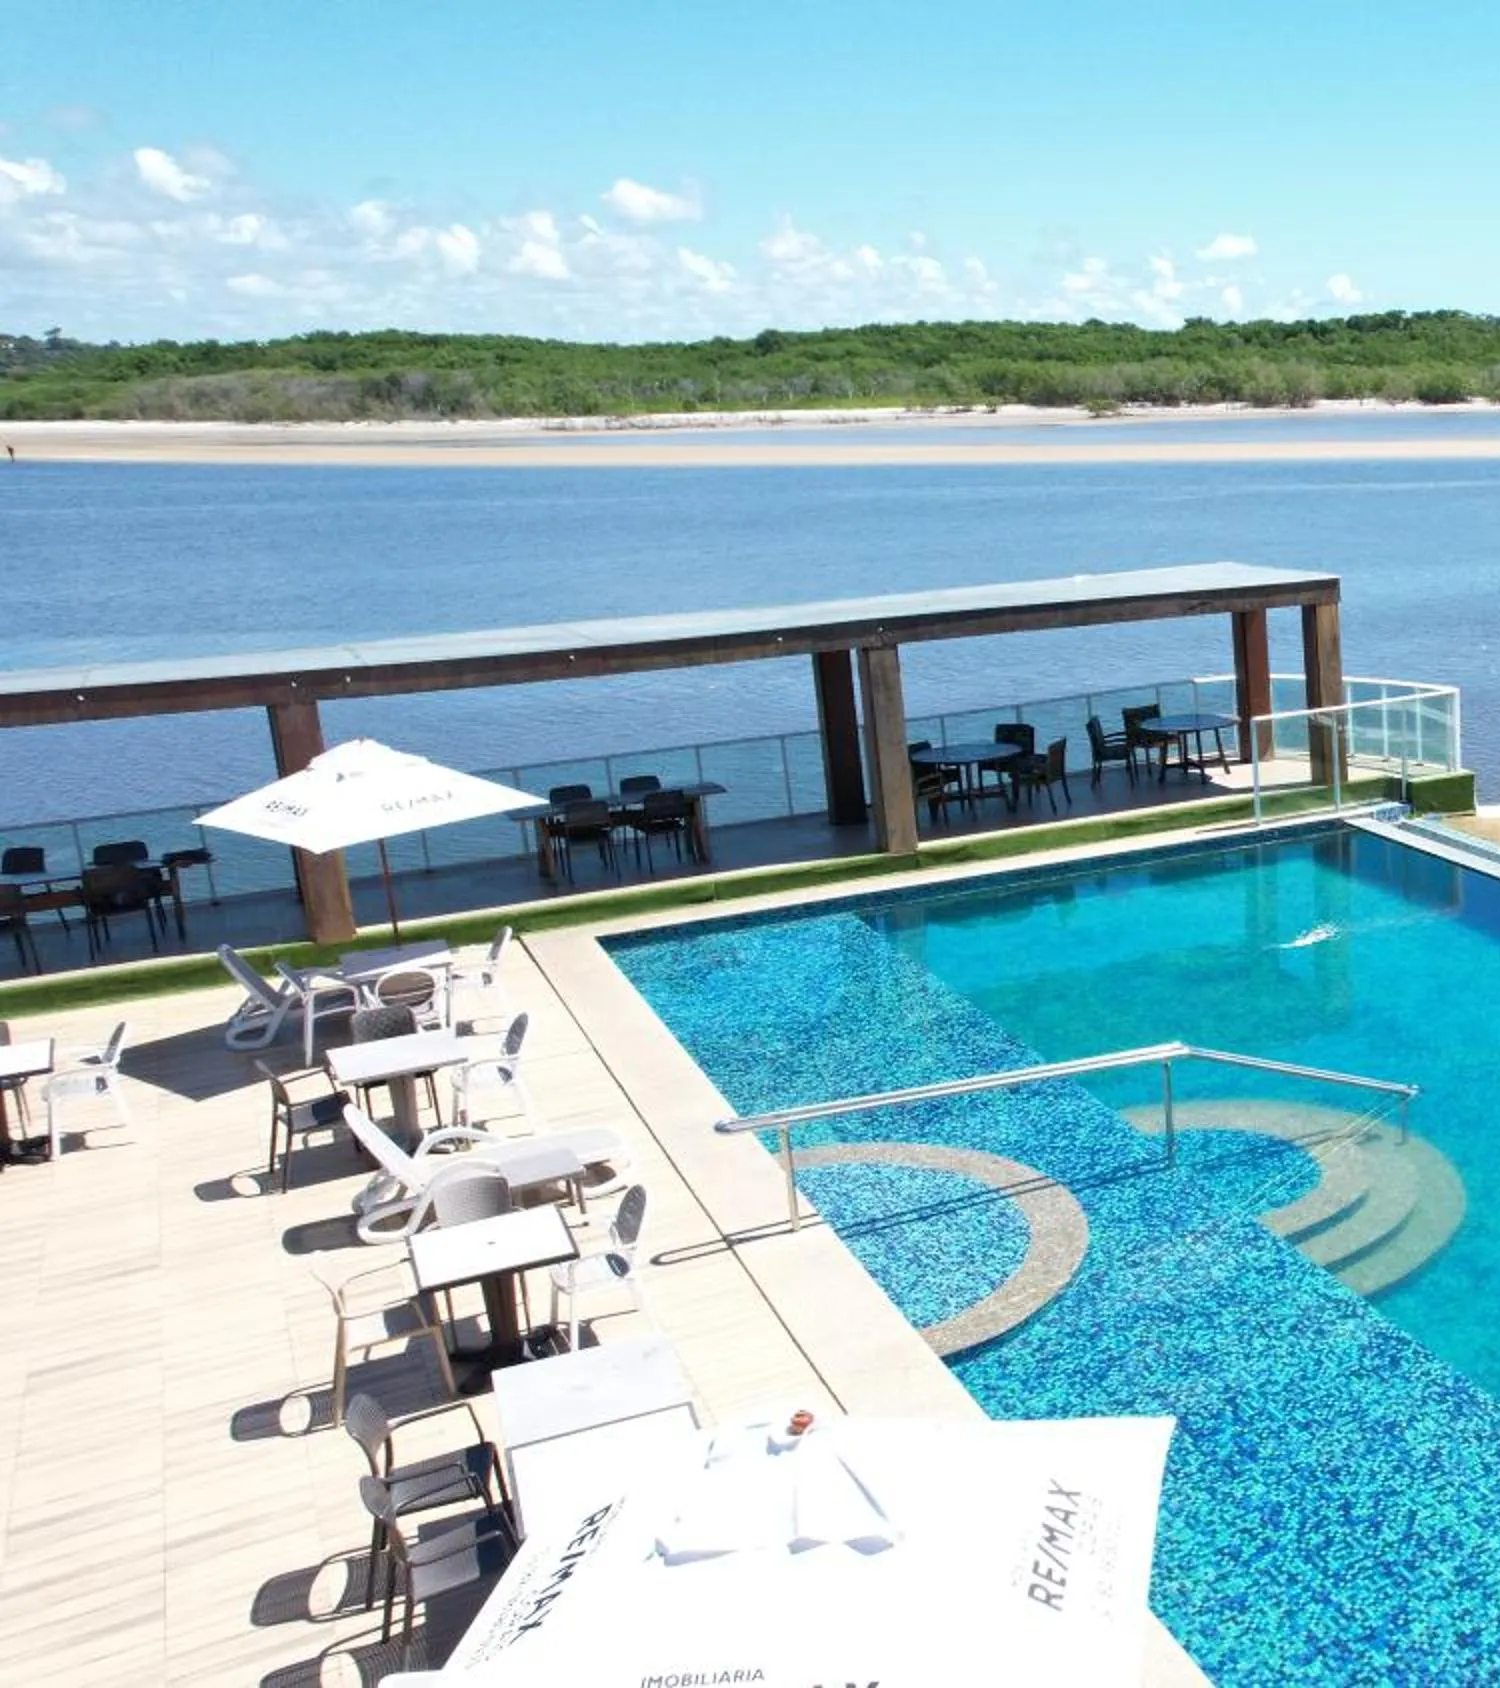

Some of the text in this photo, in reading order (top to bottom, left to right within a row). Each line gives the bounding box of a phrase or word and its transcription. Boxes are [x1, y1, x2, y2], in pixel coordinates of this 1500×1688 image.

[506, 1502, 614, 1648] RE/MAX
[1027, 1478, 1082, 1612] RE/MAX
[640, 1668, 766, 1688] IMOBILIARIA
